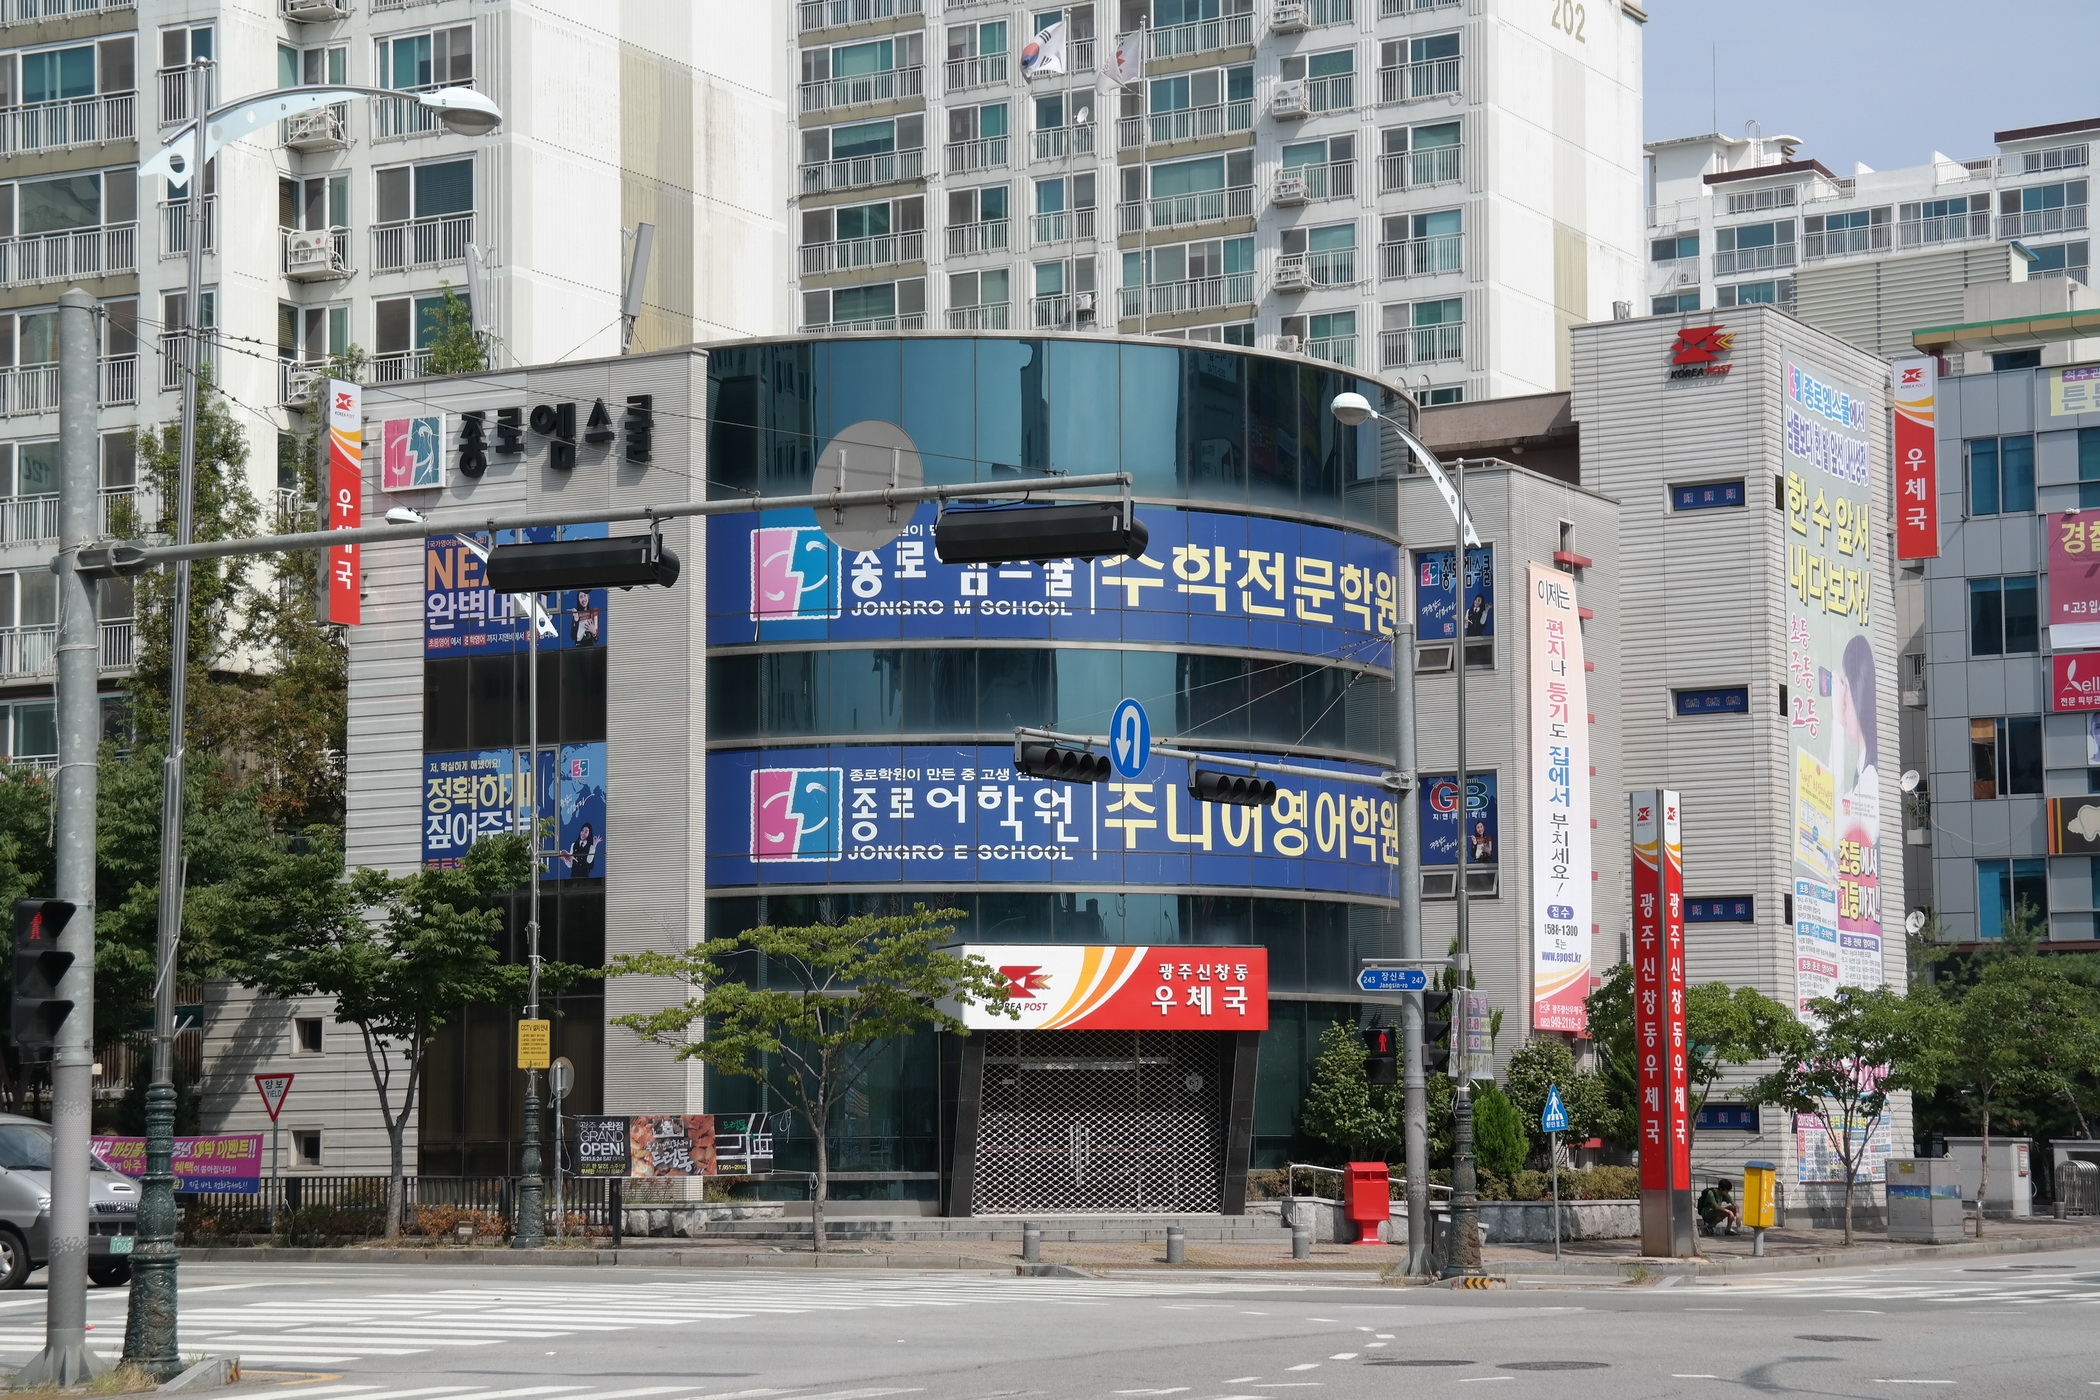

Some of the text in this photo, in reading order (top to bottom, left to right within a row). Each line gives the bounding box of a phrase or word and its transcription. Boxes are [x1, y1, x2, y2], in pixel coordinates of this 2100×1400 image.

[1551, 0, 1586, 44] 202
[1670, 364, 1733, 380] KOREA POST
[1803, 373, 1866, 432] 종로엠스쿨에서
[458, 394, 654, 478] 종로엠스쿨
[1904, 447, 1928, 531] 우체국
[1787, 470, 1870, 562] 한 수 앞서
[851, 541, 1075, 598] 종로쿨
[1101, 544, 1398, 635] 수학전문학원
[1788, 543, 1871, 626] 내다보자!
[1537, 579, 1571, 611] 이제는
[850, 600, 1073, 617] JONGRO M SCHOOL
[2089, 599, 2100, 614] 입
[1545, 617, 1571, 897] 편지나 등기도 집에서 부치세요!
[849, 768, 921, 782] 종로학원이
[926, 768, 957, 782] 만든
[960, 768, 977, 781] 중
[980, 768, 1010, 782] 고생
[426, 771, 532, 814] 정확하게
[851, 784, 1079, 842] 종로어학원
[1104, 783, 1399, 866] 주니어영어학원
[847, 844, 1074, 860] JONGRO E SCHOOL
[1839, 838, 1878, 880] 초등에서
[1551, 906, 1569, 919] 접수
[1541, 951, 1582, 964] www.epost.kr
[1158, 962, 1249, 982] 광주신창동
[1363, 971, 1424, 984] 243 장신로 247
[1378, 982, 1409, 990] Jangsin-ro
[1023, 1002, 1049, 1012] POST
[1151, 984, 1249, 1016] 우체국
[520, 1024, 533, 1032] CCTV
[265, 1079, 284, 1090] 양보
[266, 1089, 282, 1098] YIELD
[580, 1121, 624, 1131] 광주 수완점
[579, 1130, 625, 1142] GRAND
[216, 1138, 257, 1159] 이벤트!!
[579, 1141, 625, 1157] OPEN!
[123, 1159, 142, 1172] 아주
